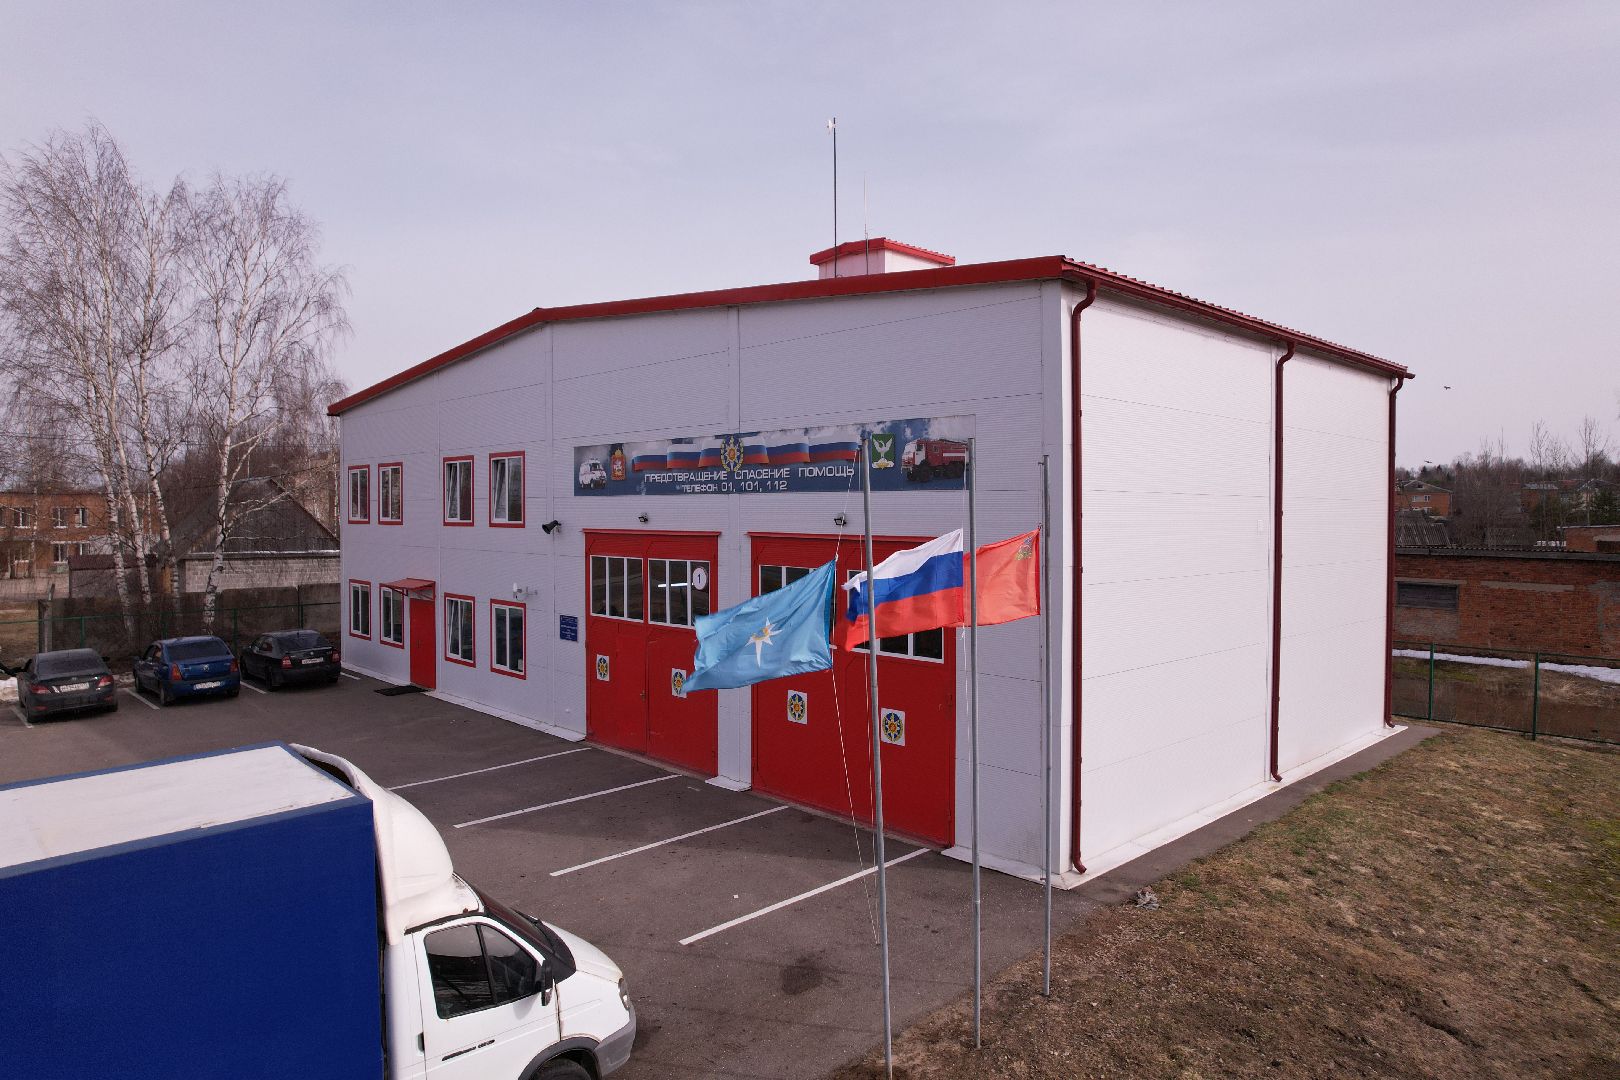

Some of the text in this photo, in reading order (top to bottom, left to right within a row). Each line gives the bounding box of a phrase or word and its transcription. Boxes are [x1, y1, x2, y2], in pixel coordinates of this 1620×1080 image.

[734, 467, 791, 480] СПАСЕНИЕ
[798, 465, 855, 478] ПОМОЩЬ
[681, 480, 788, 493] ТЕЛЕФОН 01, 101, 112
